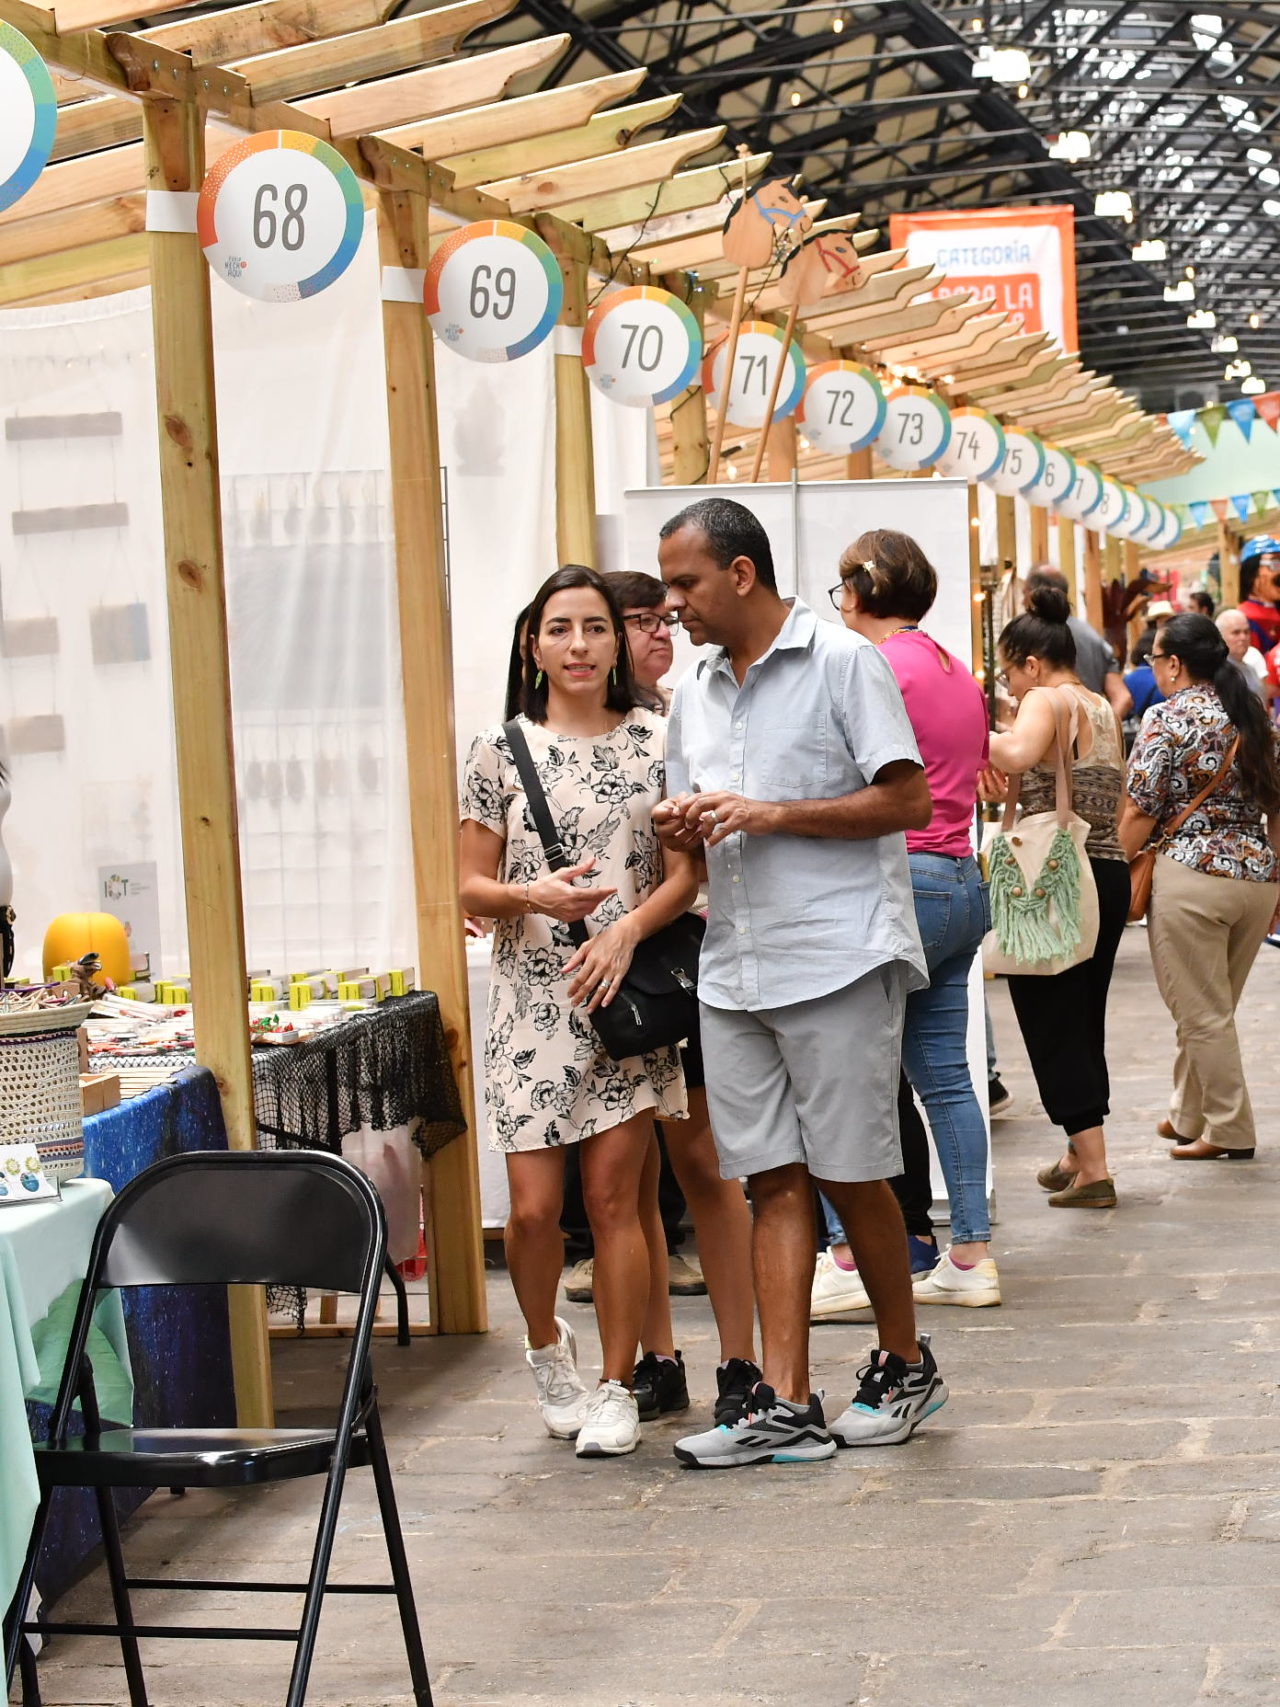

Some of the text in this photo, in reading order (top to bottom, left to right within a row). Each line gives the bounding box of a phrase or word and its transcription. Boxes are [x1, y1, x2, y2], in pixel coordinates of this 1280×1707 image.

[253, 184, 308, 251] 68
[470, 264, 516, 321] 69
[1004, 283, 1033, 310] LA
[620, 324, 663, 371] 70
[740, 355, 767, 396] 71
[826, 390, 855, 426] 72
[898, 413, 924, 445] 73
[956, 432, 980, 460] 74
[1001, 449, 1022, 475] 75
[1045, 463, 1055, 487] 6
